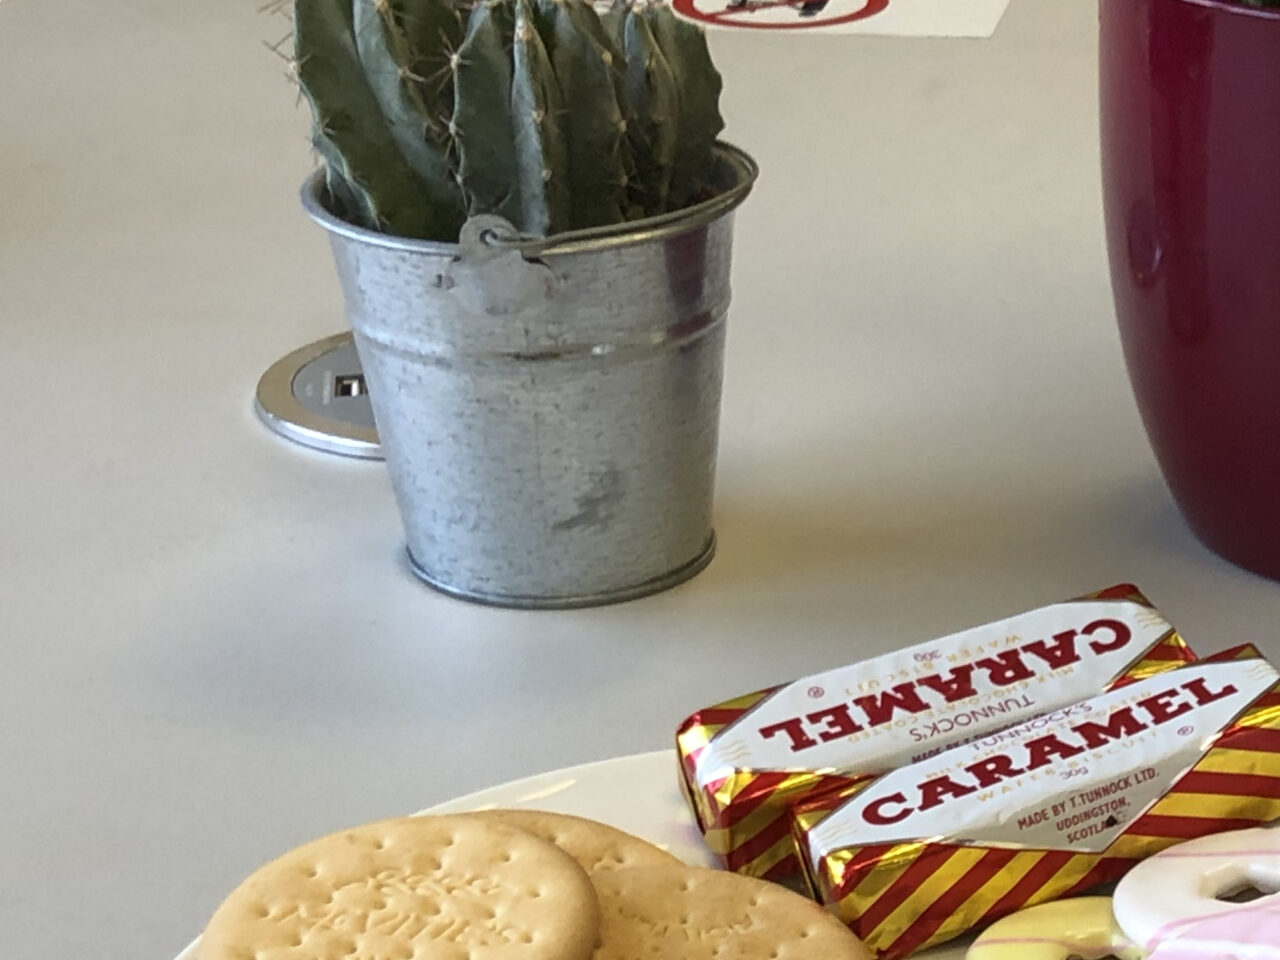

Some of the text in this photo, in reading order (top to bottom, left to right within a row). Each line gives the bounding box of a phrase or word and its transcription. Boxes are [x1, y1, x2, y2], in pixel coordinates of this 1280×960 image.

[758, 619, 1132, 752] CARAMEL
[909, 694, 1036, 742] TUNNOCK'S
[970, 702, 1093, 750] TUNNOCK'S
[861, 677, 1239, 825] CARAMEL
[1017, 808, 1050, 831] MADE
[1051, 801, 1067, 817] BY
[1134, 767, 1160, 785] LTD.
[1056, 796, 1131, 831] UDDINGSTON,
